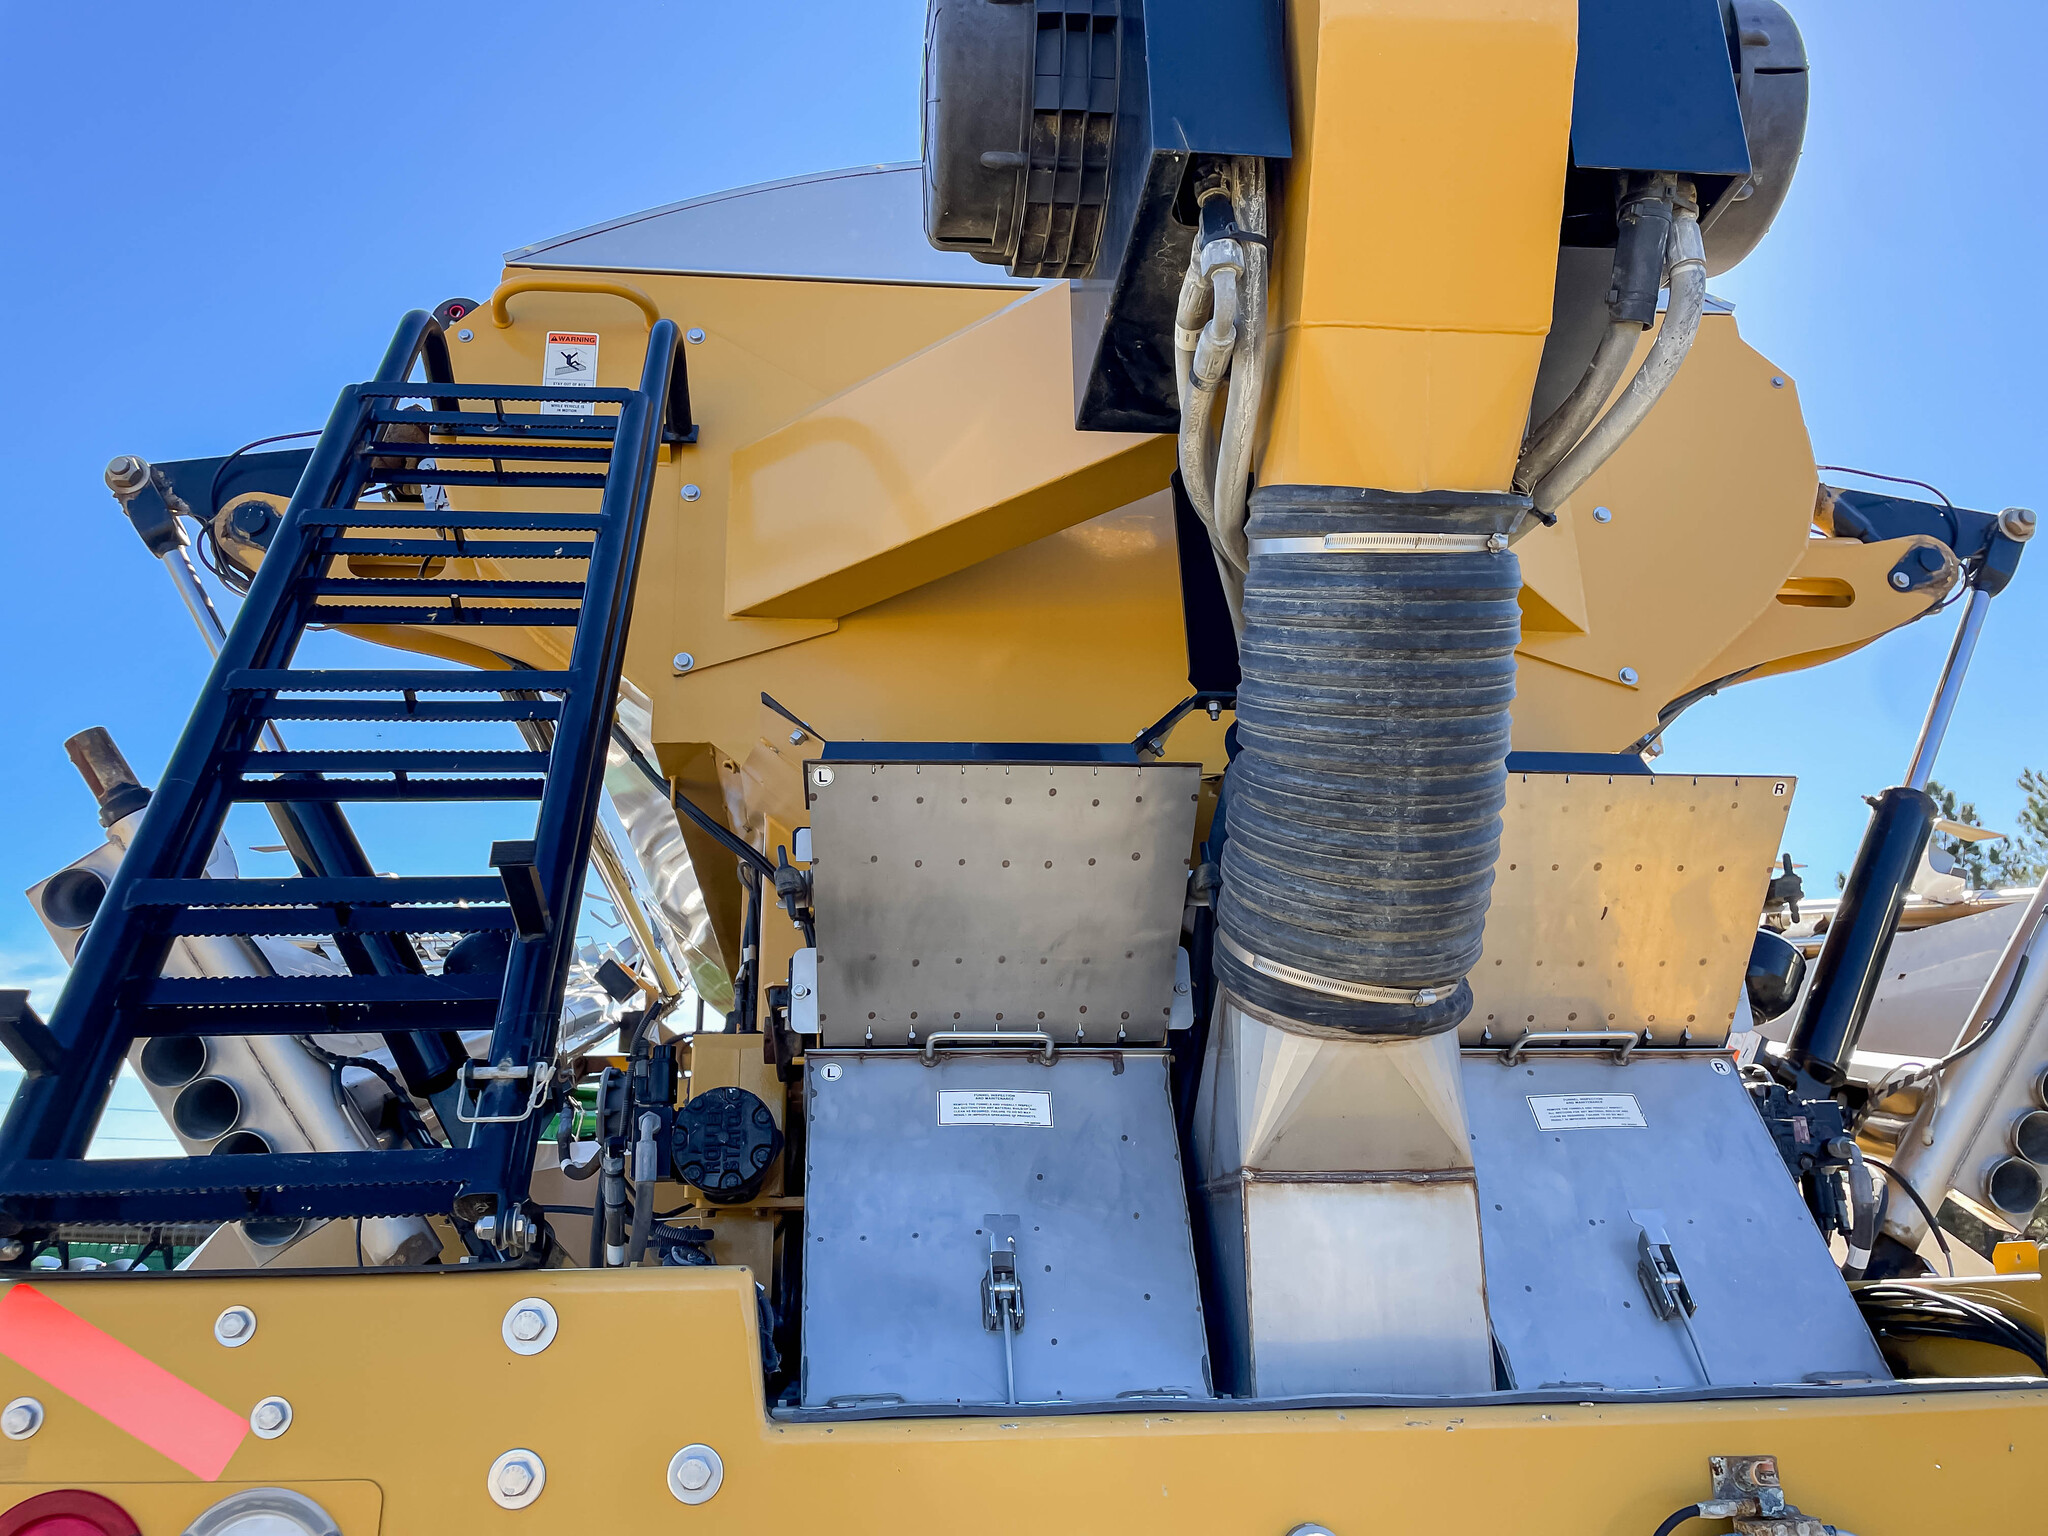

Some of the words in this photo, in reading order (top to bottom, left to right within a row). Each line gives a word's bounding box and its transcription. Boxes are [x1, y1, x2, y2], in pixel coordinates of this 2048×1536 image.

[819, 771, 828, 782] L
[1774, 784, 1785, 795] R
[1714, 1063, 1726, 1072] R
[827, 1069, 836, 1078] L
